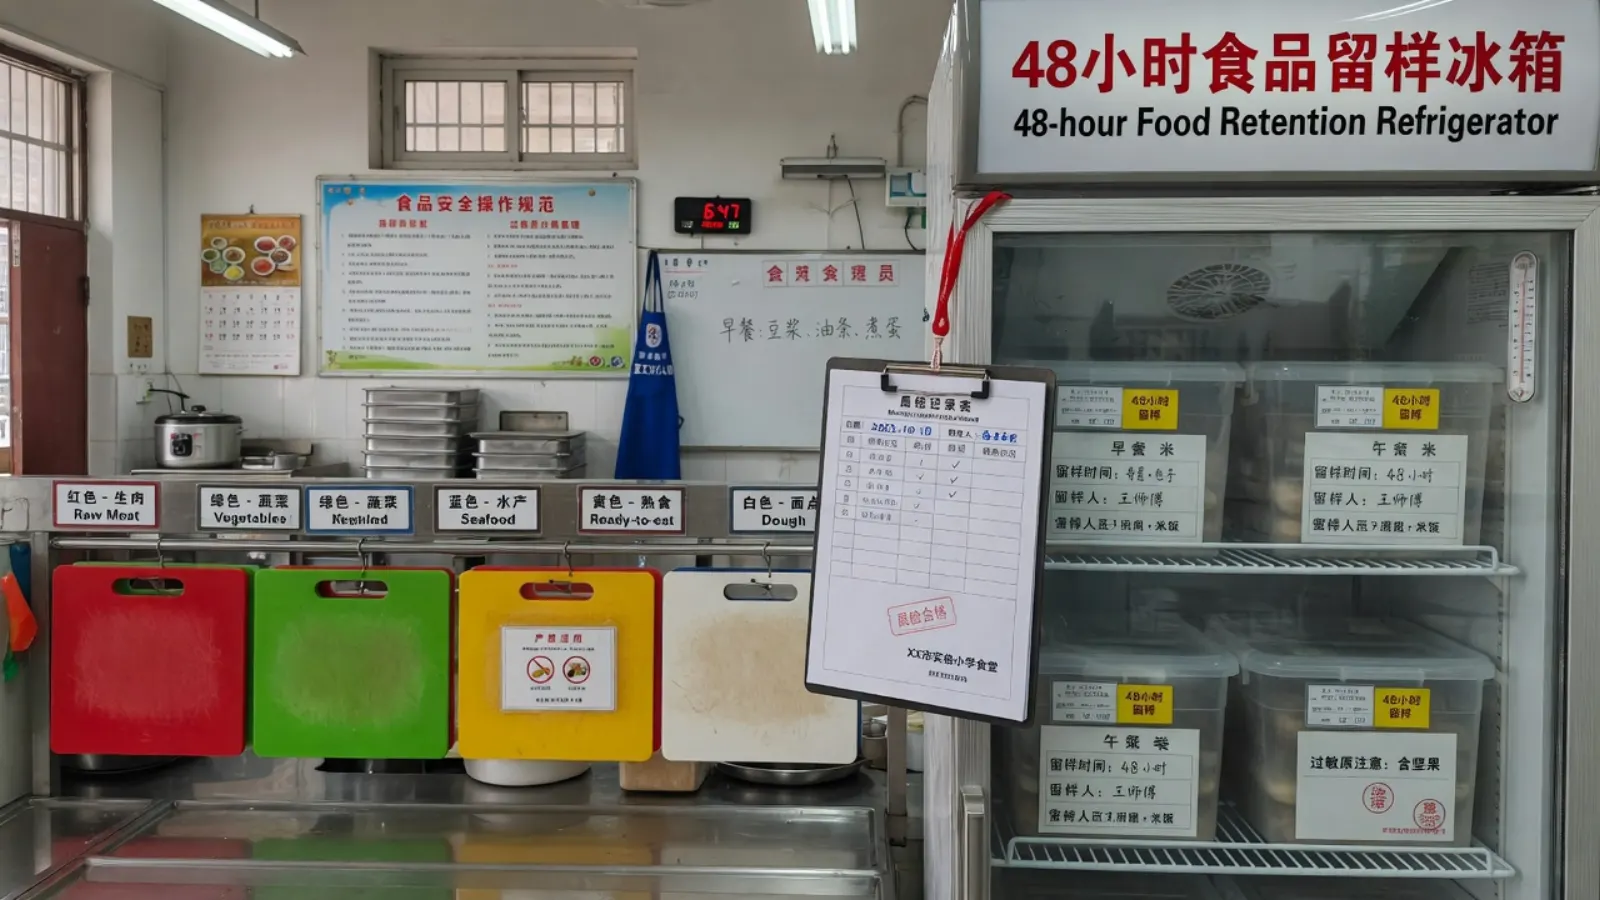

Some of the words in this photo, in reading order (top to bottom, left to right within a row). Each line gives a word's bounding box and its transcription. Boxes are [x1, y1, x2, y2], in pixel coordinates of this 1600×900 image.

[1011, 30, 1565, 94] 48小时食品留样冰箱
[1013, 107, 1127, 137] 48-hour
[1137, 106, 1210, 136] Food
[1220, 105, 1365, 136] Retention
[1376, 104, 1559, 142] Refrigerator
[397, 193, 555, 213] 食品安全操作规范
[74, 509, 102, 521] Raw
[461, 513, 516, 525] Seafood
[762, 514, 806, 528] Dough
